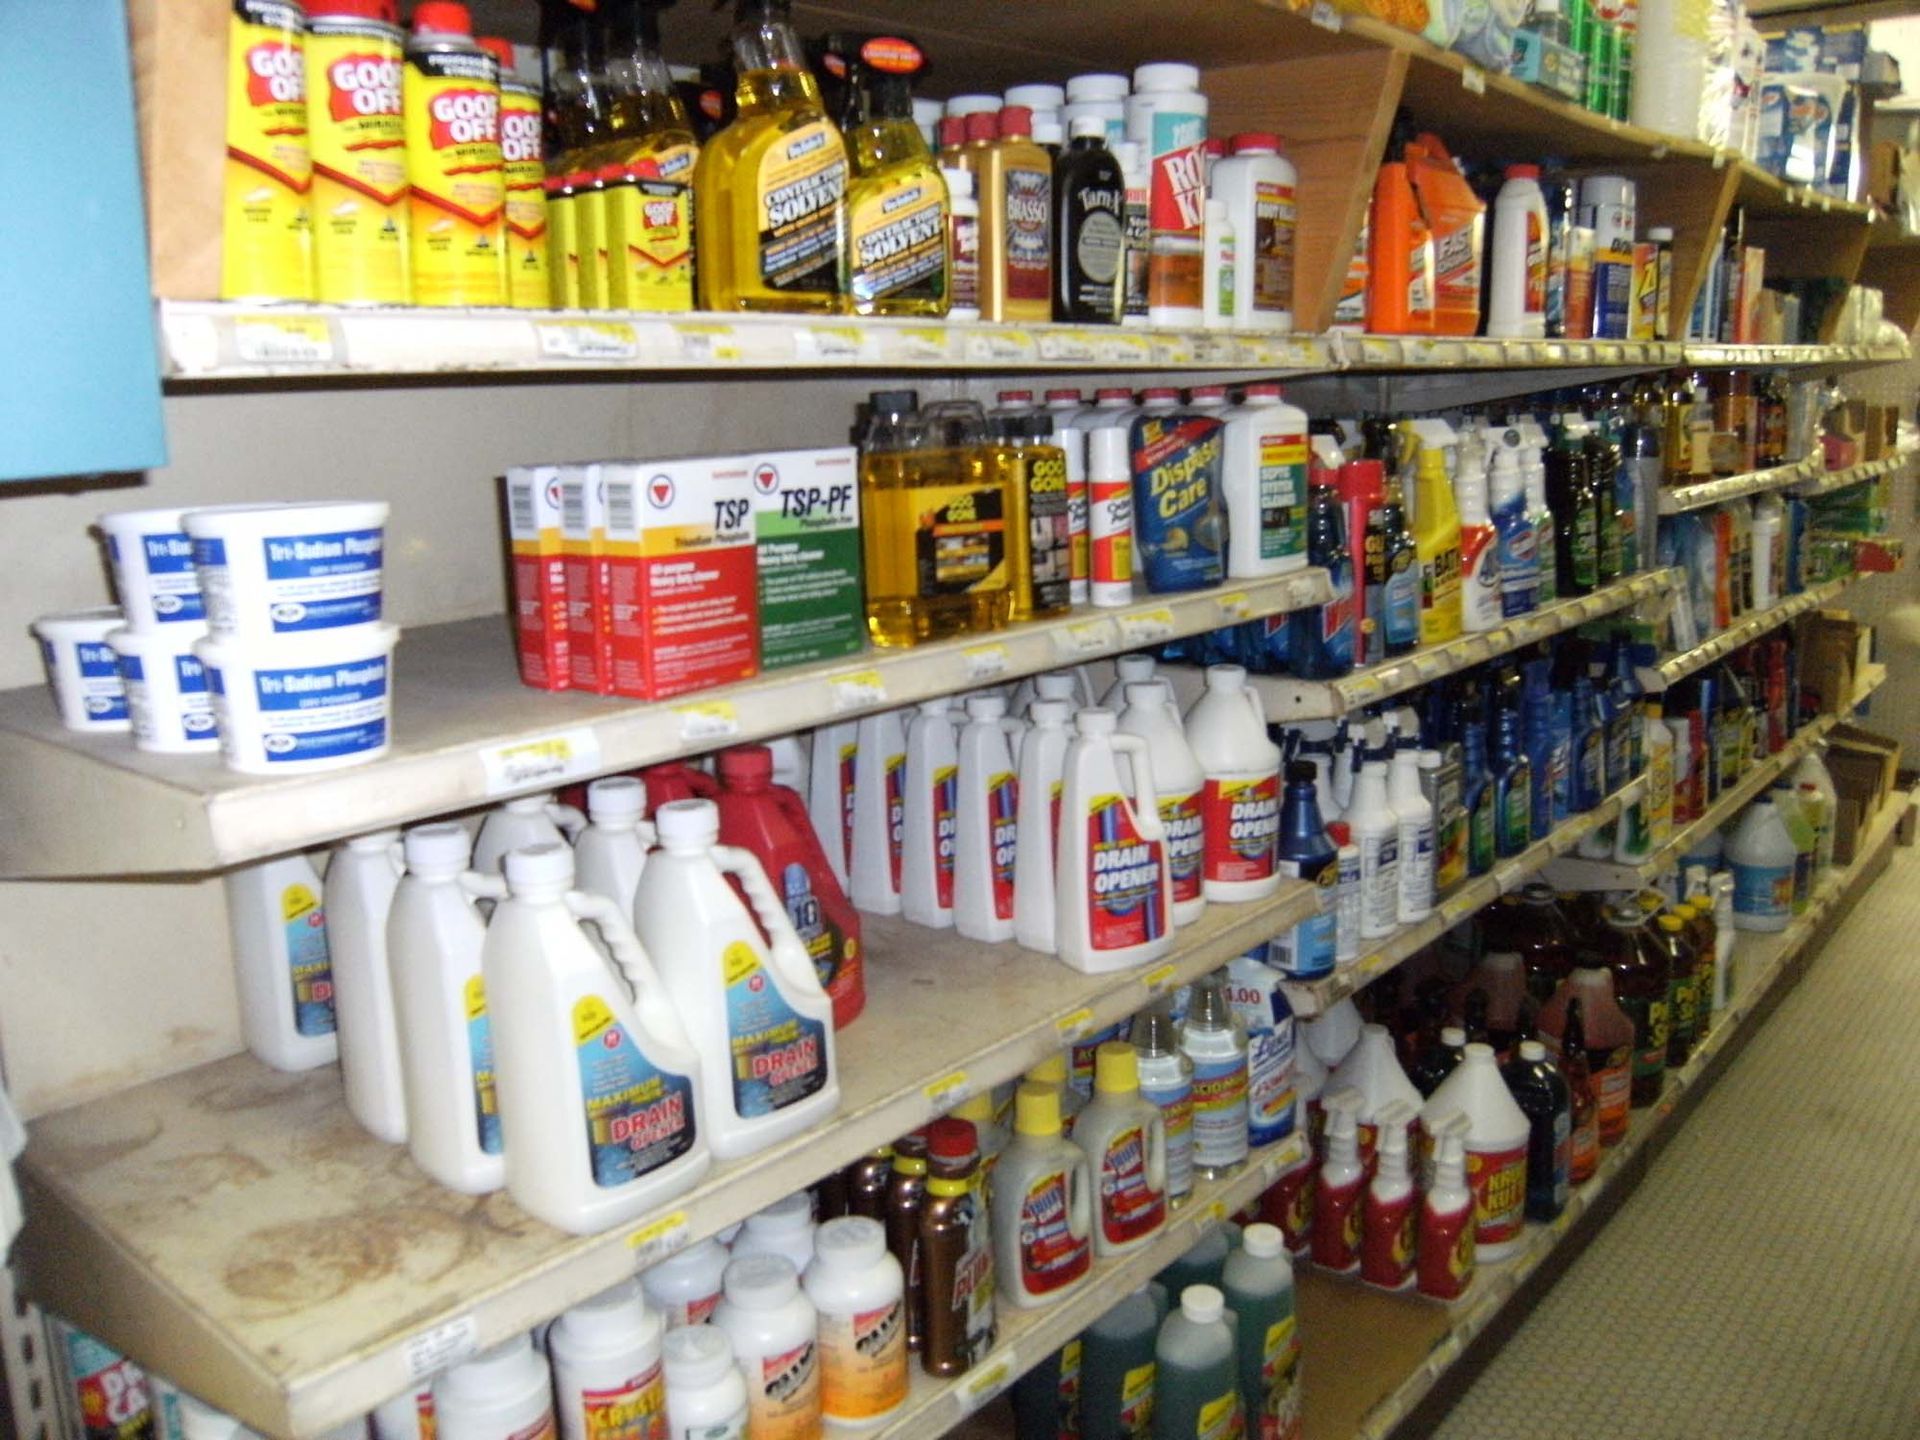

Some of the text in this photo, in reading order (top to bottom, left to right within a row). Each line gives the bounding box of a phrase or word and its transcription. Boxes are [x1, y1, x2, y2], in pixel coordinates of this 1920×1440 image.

[450, 119, 496, 143] OFF
[1007, 194, 1047, 223] BRASSO
[780, 485, 852, 518] TSP-PF
[1159, 478, 1206, 518] Care
[714, 498, 749, 530] TSP
[1093, 844, 1150, 873] DRAIN
[1094, 862, 1159, 893] OPENER
[610, 1090, 684, 1145] DRAIN
